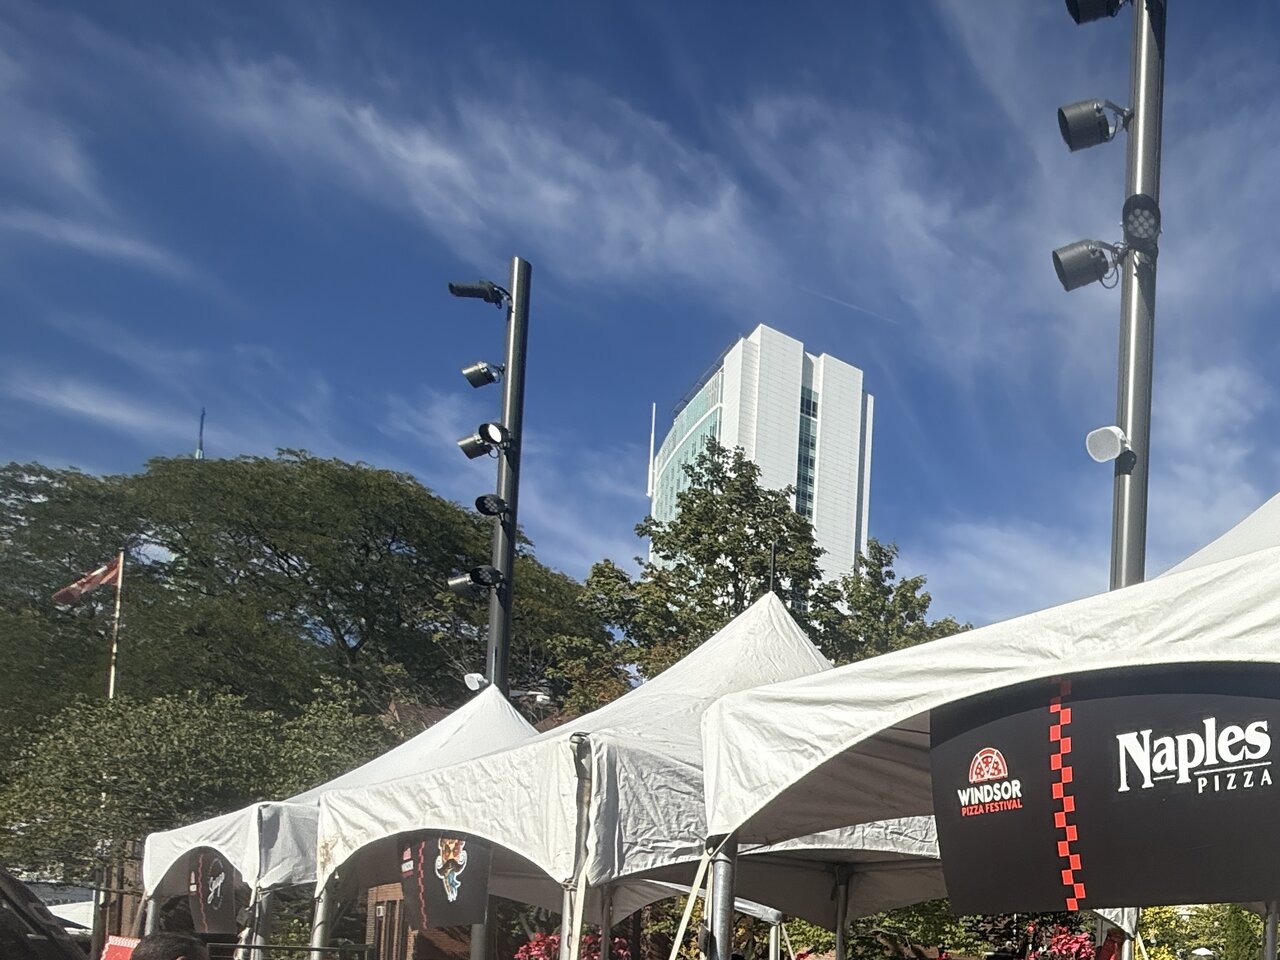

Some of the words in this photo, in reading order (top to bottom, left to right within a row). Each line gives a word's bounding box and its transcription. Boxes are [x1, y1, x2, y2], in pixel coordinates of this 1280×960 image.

[1116, 716, 1272, 792] Naples
[957, 779, 1023, 806] WINDSOR
[1197, 769, 1273, 794] PIZZA
[961, 804, 985, 817] PIZZA
[984, 798, 1024, 814] FESTIVAL
